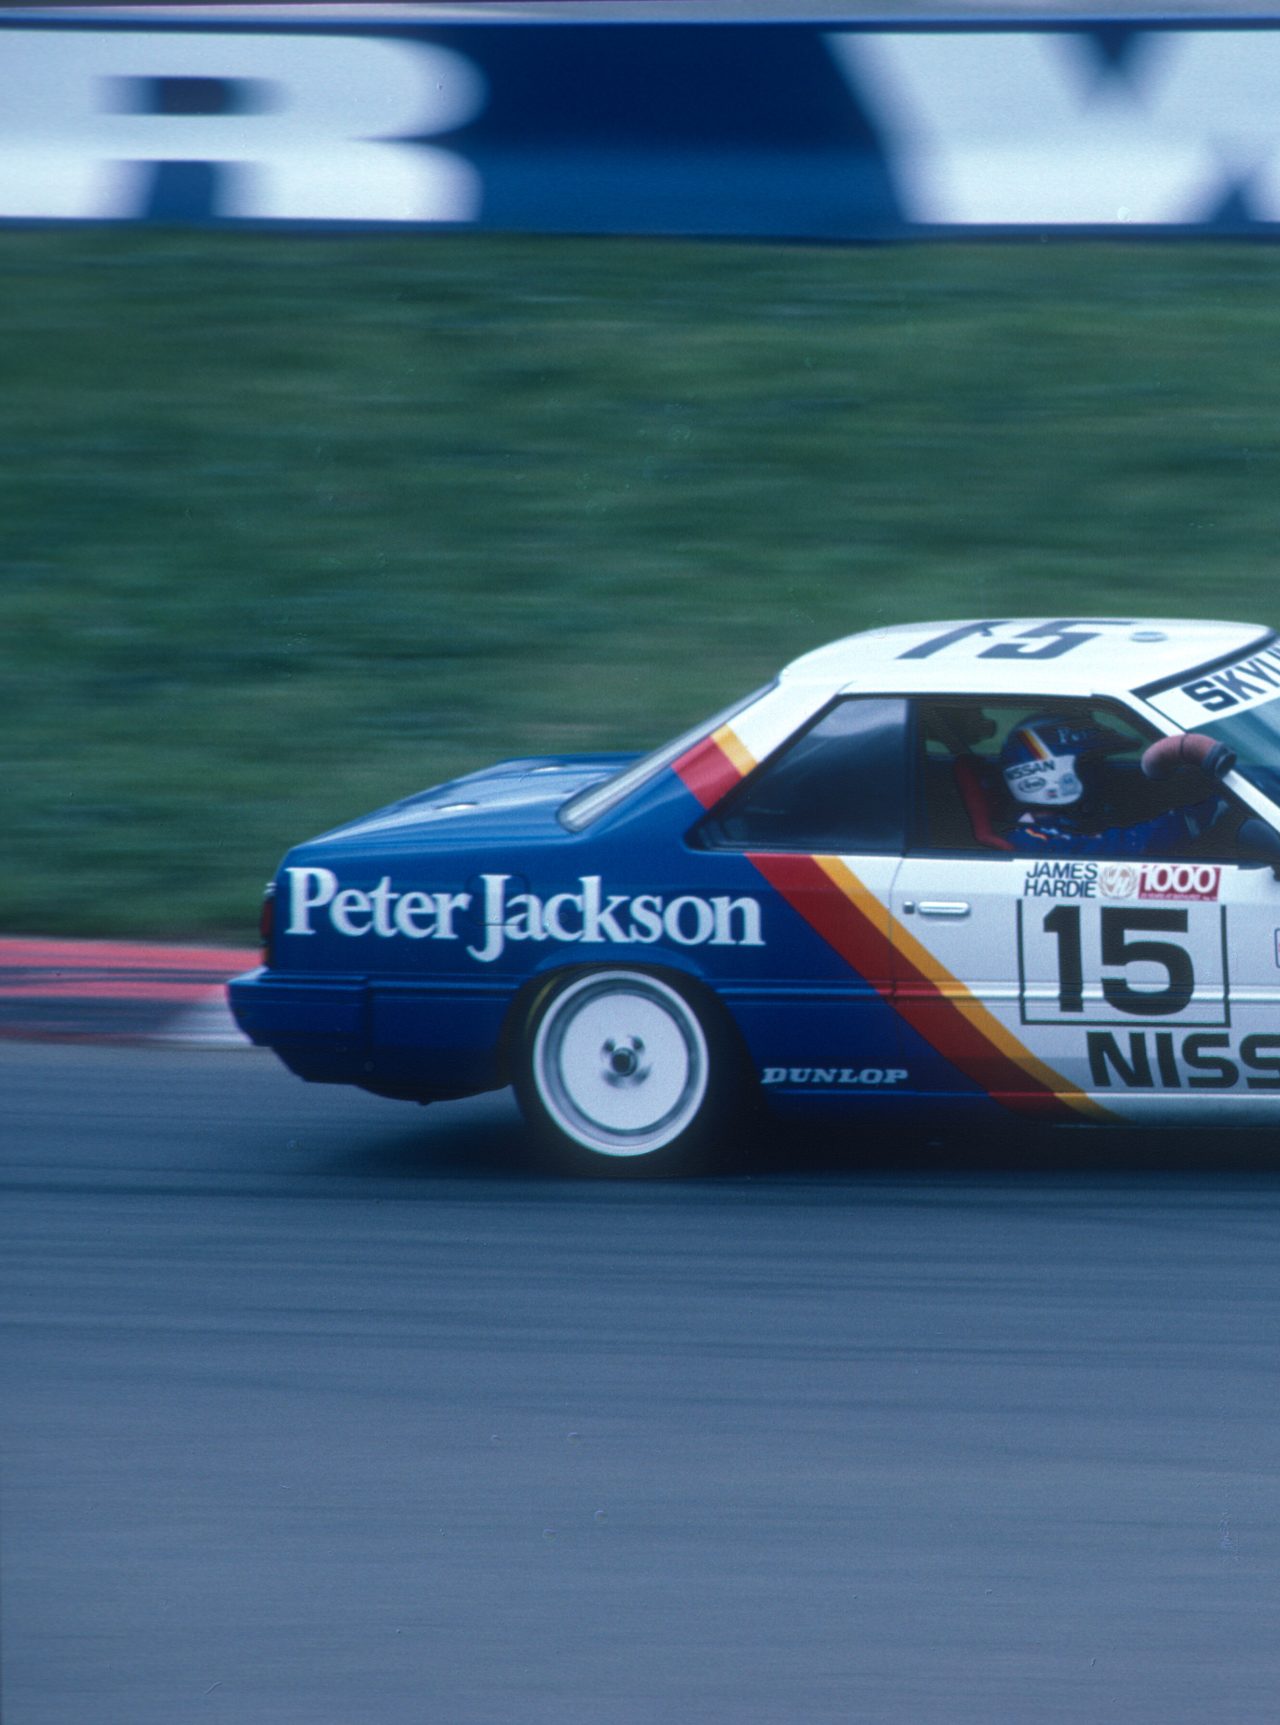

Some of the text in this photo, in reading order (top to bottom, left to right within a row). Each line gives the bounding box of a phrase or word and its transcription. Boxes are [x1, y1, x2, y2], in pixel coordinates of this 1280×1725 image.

[894, 620, 1136, 660] 15
[1026, 862, 1098, 880] JAMES
[1023, 879, 1097, 898] HARDIE
[284, 867, 766, 962] Peter Jackson
[1042, 904, 1195, 1016] 15
[760, 1067, 909, 1084] DUNLOP
